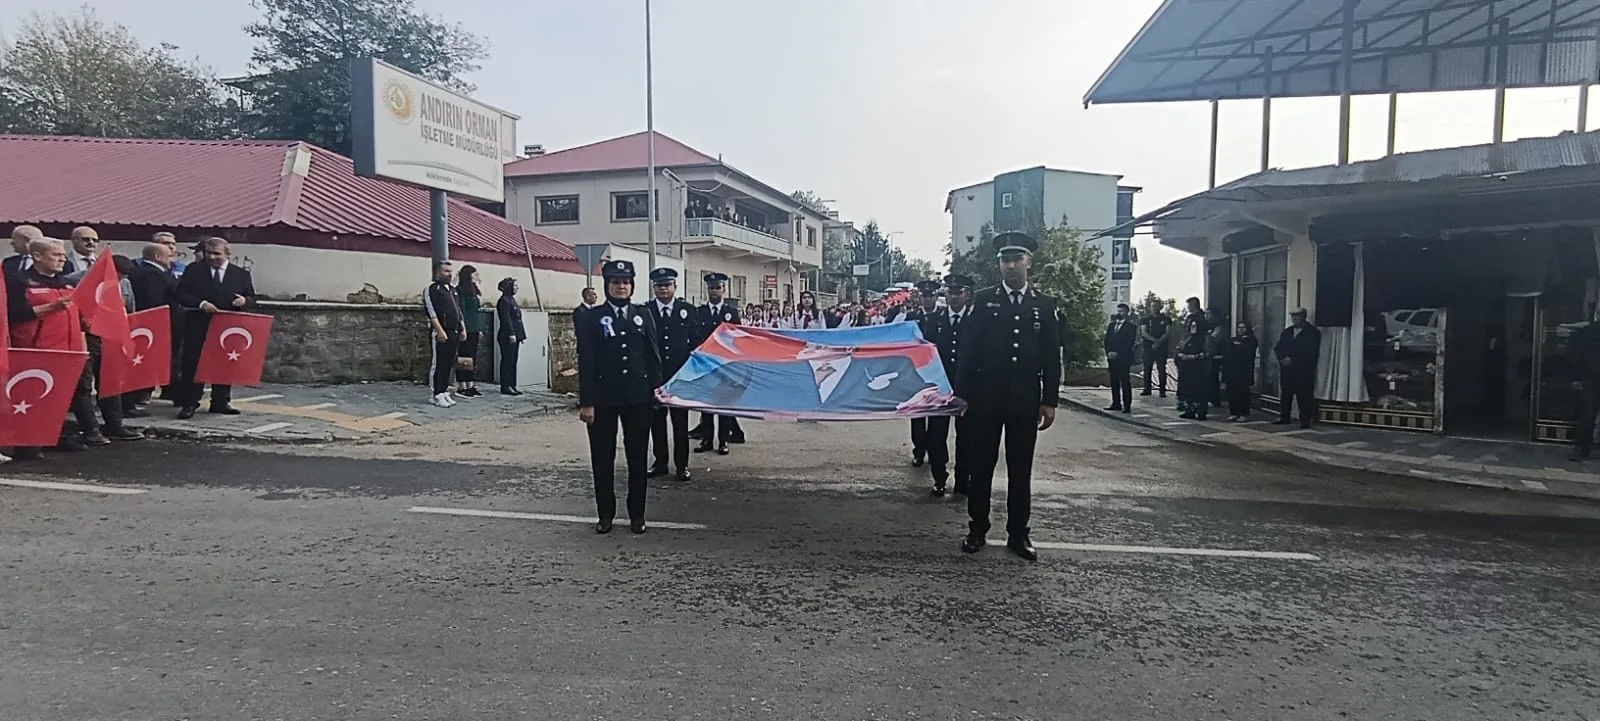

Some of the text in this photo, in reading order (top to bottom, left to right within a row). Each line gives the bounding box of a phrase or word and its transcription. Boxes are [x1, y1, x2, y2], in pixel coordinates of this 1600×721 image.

[420, 93, 498, 143] ANDIRIN ORMAN
[420, 120, 499, 160] İŞLETME MÜDÜRLÜĞÜ
